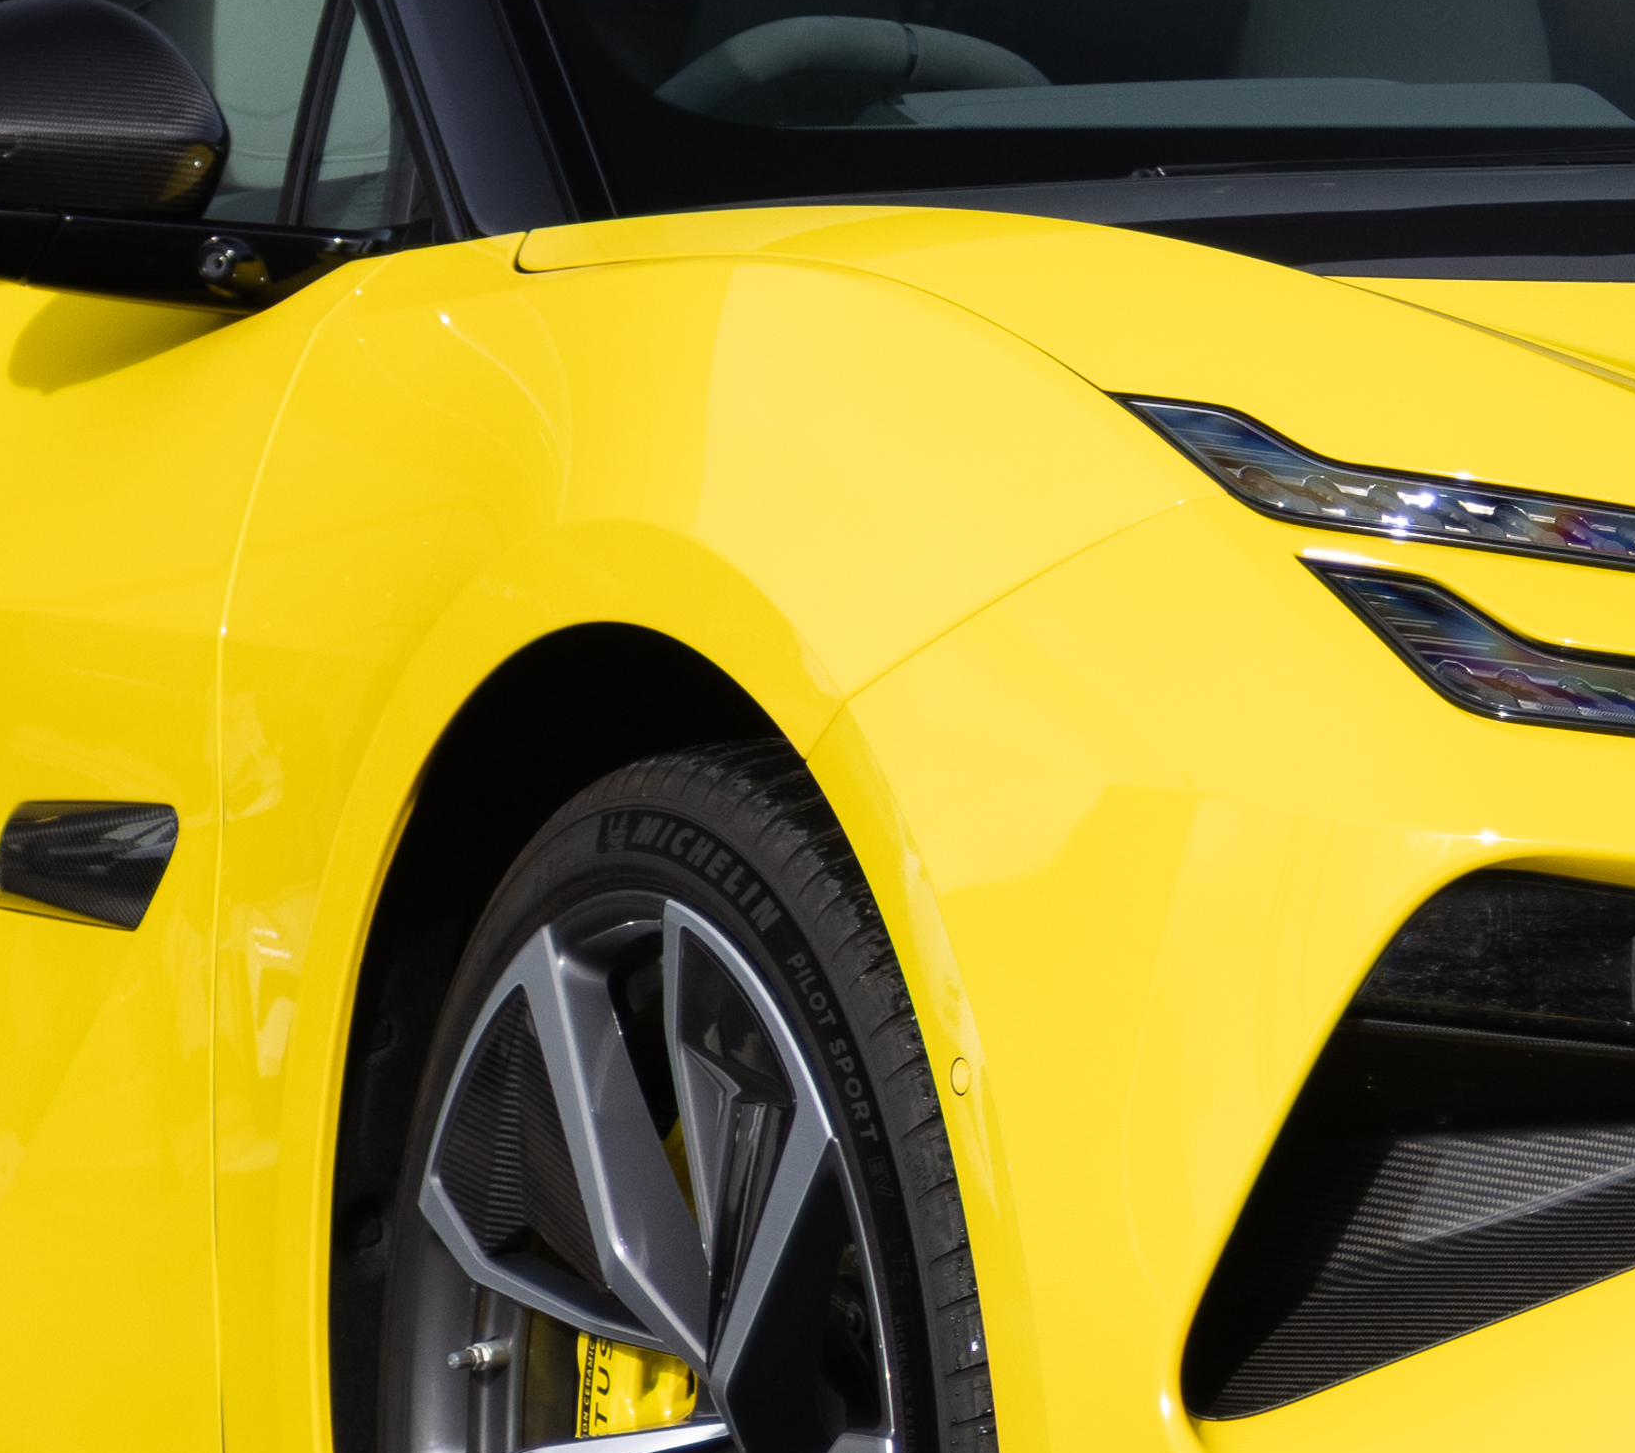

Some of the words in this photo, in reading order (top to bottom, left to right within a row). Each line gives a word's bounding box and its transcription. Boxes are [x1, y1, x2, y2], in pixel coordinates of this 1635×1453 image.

[631, 816, 783, 932] MICHELIN
[785, 951, 838, 1026] PILOT
[828, 1037, 881, 1143] SPORT
[867, 1155, 896, 1198] EV
[583, 1340, 596, 1405] CERAMIC
[594, 1339, 613, 1427] TUS
